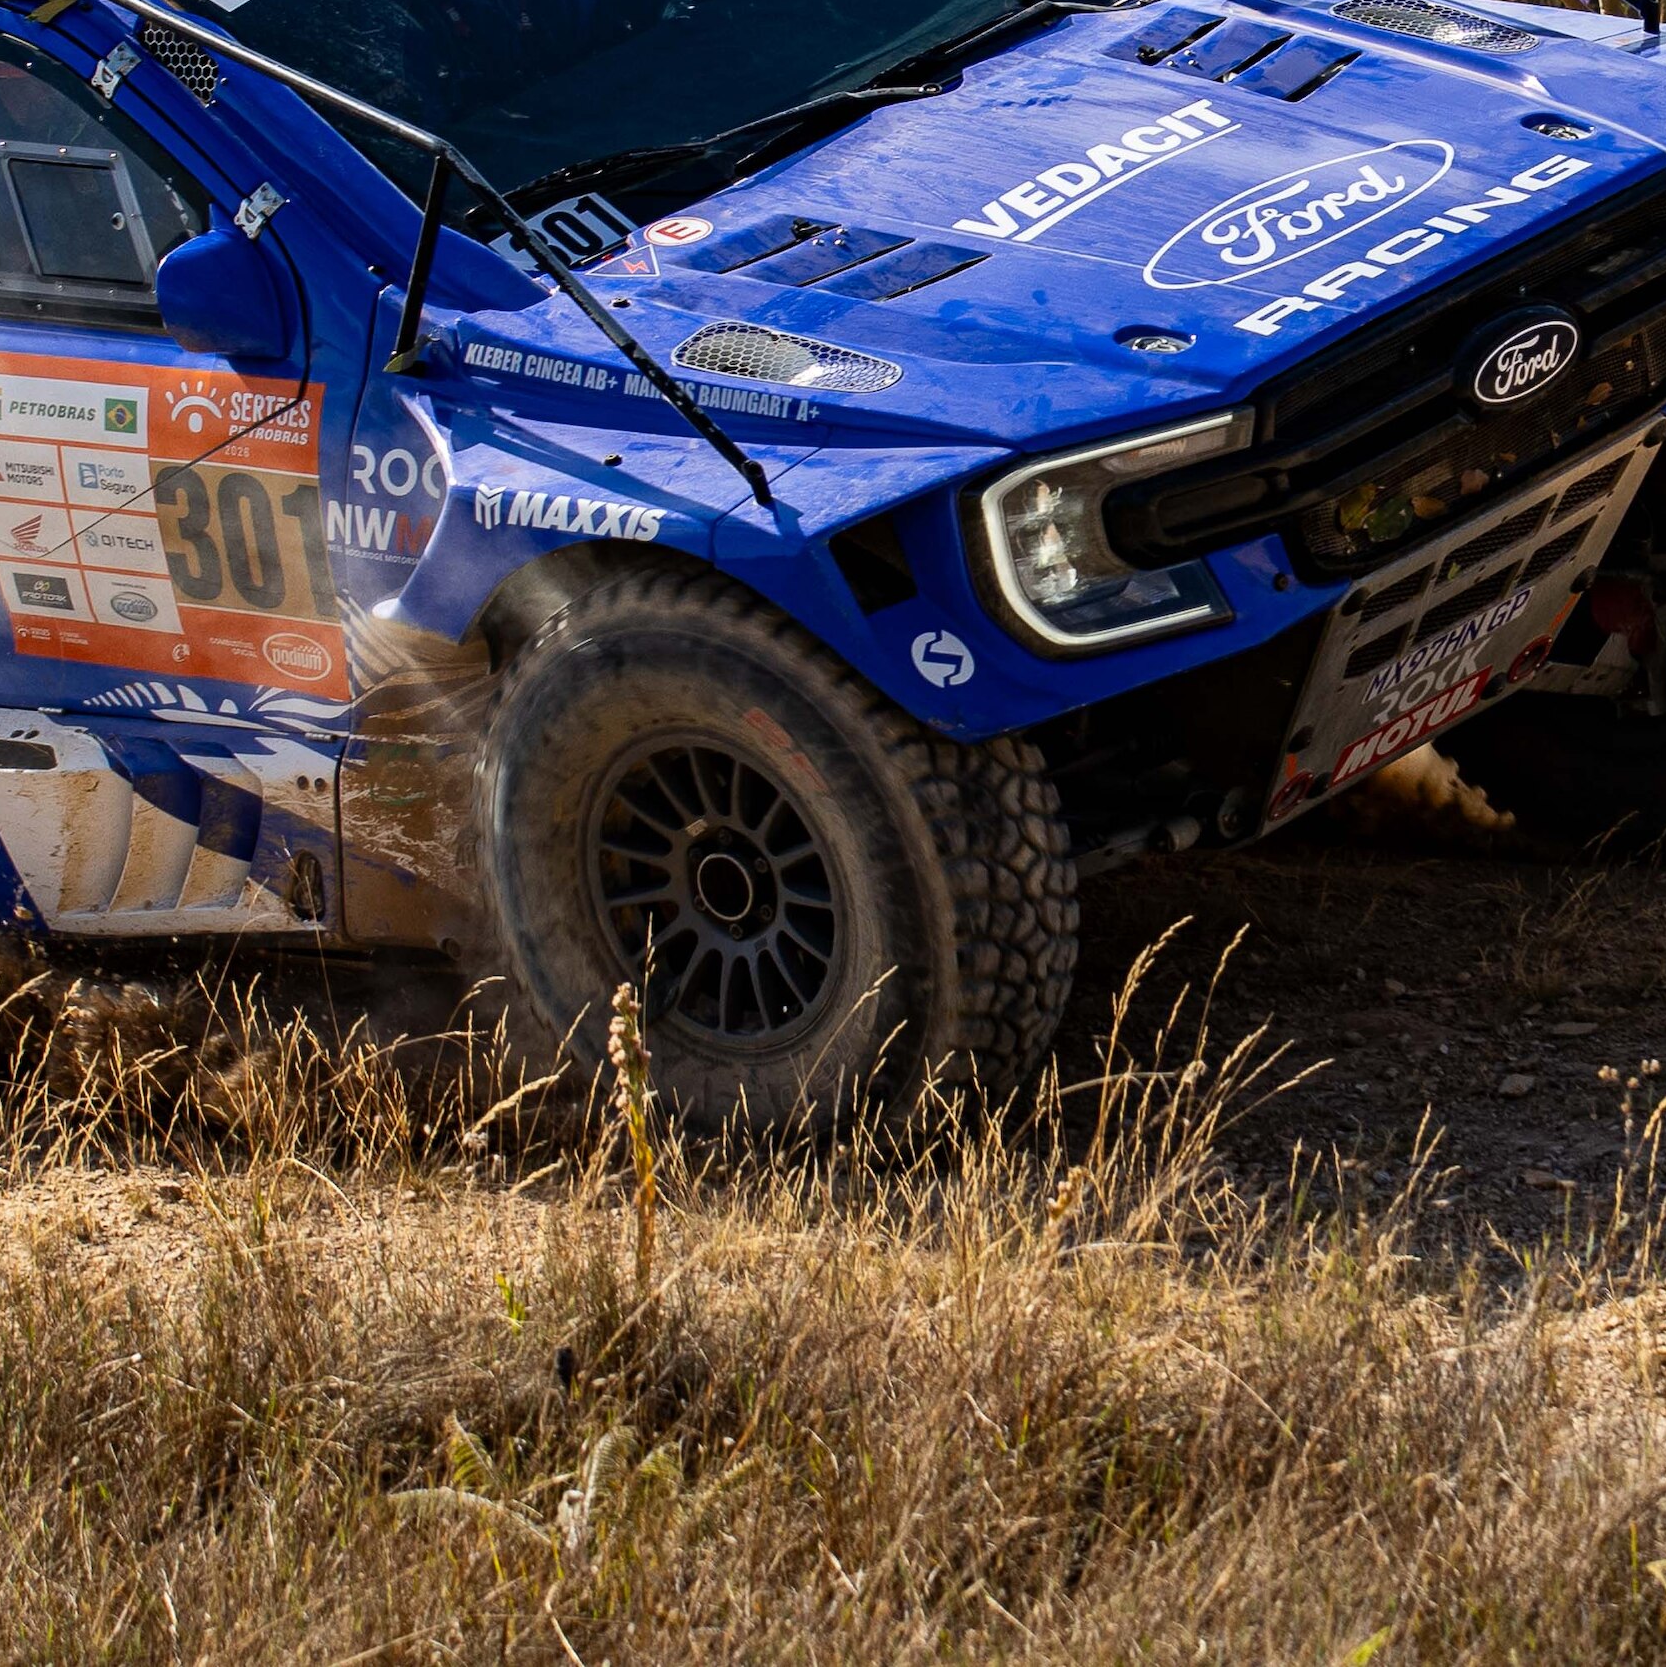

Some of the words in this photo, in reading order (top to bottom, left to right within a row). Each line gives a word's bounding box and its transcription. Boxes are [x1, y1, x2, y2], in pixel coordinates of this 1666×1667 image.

[951, 98, 1232, 239] VEDACIT
[655, 221, 702, 241] E
[1200, 164, 1407, 266] Ford
[1233, 154, 1594, 336] RACING
[463, 342, 523, 374] KLEBER
[524, 354, 583, 386] CINCEA
[583, 366, 619, 391] AB+
[623, 372, 696, 400] MARS
[697, 385, 793, 419] BAUMGART
[796, 399, 821, 422] A+
[1494, 333, 1561, 396] Ford
[9, 400, 97, 422] PETROBRAS
[228, 424, 309, 446] PETROBRAS
[5, 461, 55, 477] MITSUBISHI
[7, 473, 44, 487] MOTORS
[97, 464, 126, 479] Porto
[99, 478, 137, 495] Seguro
[154, 466, 335, 616] 301
[506, 489, 668, 542] MAXXIS
[271, 648, 322, 671] podium
[1364, 612, 1488, 703] MX97HN
[1486, 589, 1533, 633] GP
[1333, 675, 1482, 783] MOTUL
